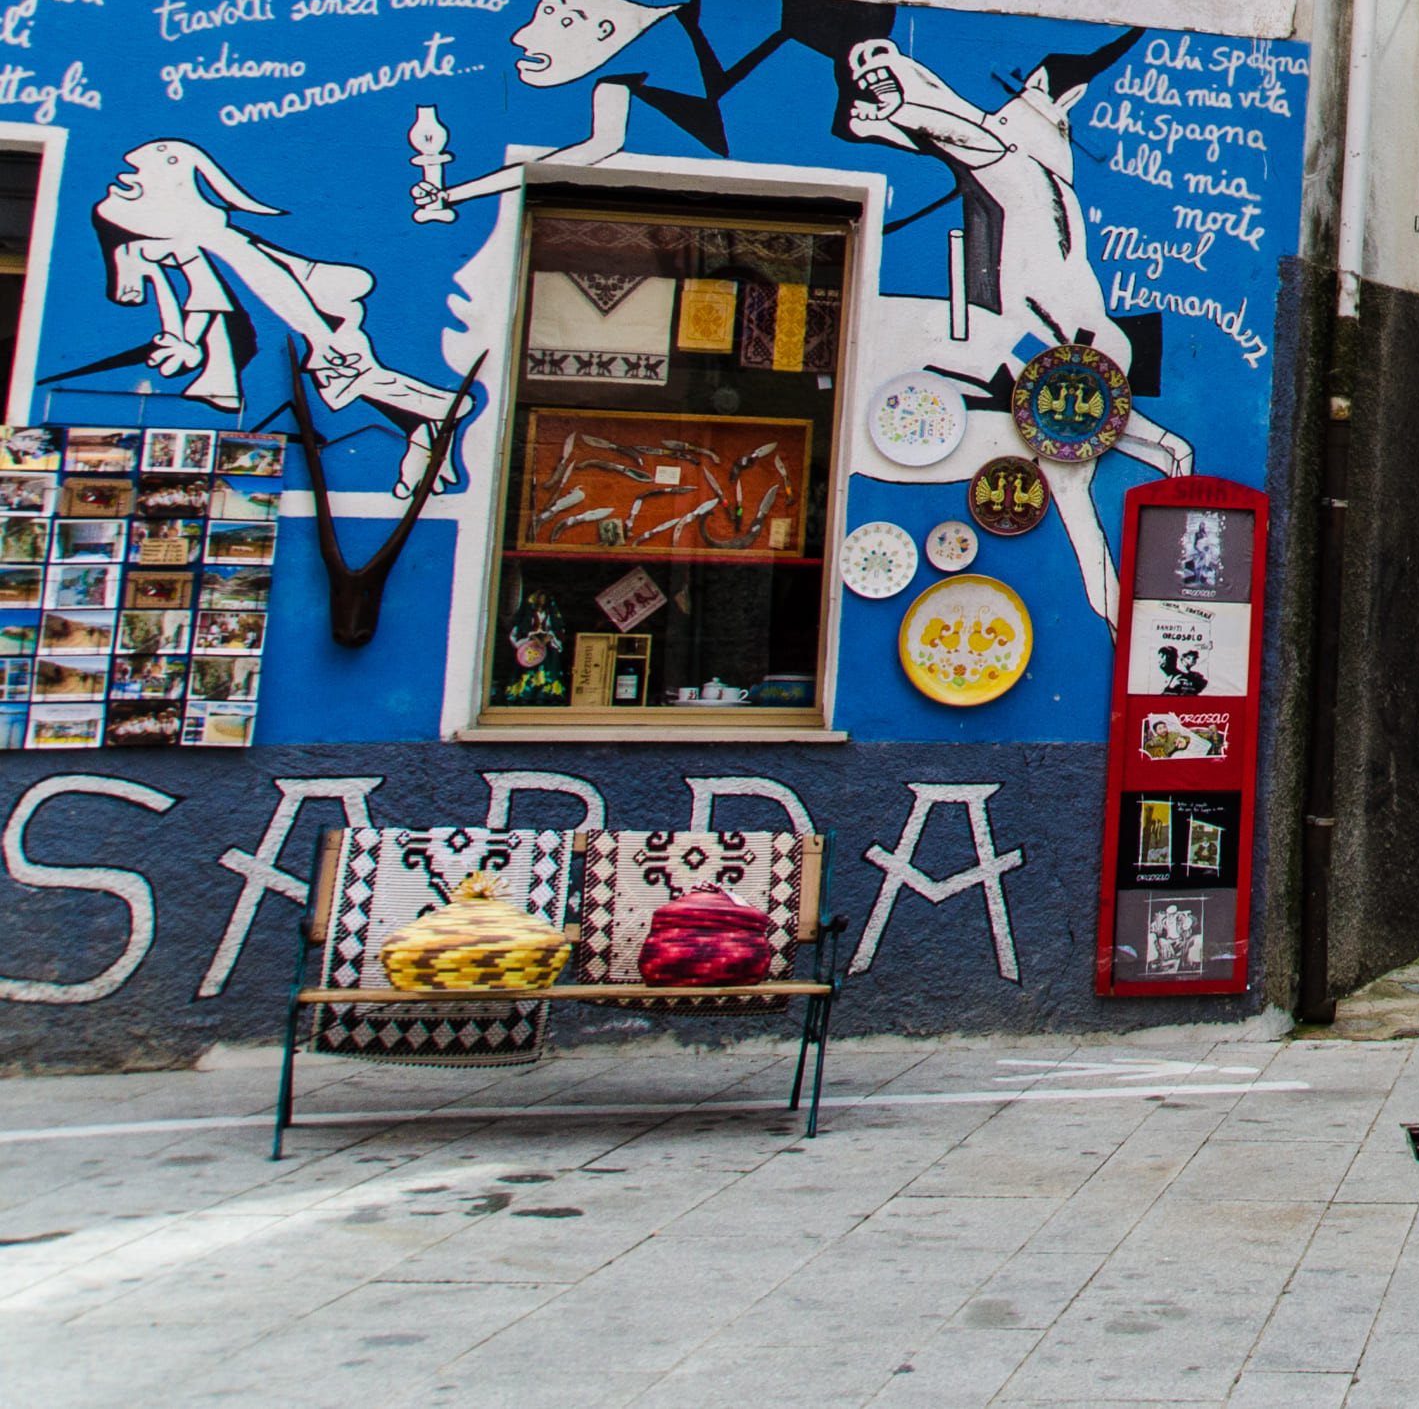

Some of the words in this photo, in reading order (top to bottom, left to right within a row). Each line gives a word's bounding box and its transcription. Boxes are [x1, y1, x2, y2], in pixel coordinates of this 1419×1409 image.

[160, 41, 307, 101] gridiamo
[1114, 65, 1182, 106] della
[1185, 87, 1233, 110] mia
[1238, 85, 1292, 118] vita
[1144, 35, 1204, 73] Ahi
[1209, 45, 1310, 90] Spagna
[1088, 101, 1146, 138] Ahi
[1147, 115, 1267, 163] Spagna
[1109, 141, 1173, 188] della
[1183, 169, 1261, 201] mia
[1173, 204, 1265, 252] morte
[1109, 271, 1269, 370] Hernandez
[1178, 712, 1230, 725] ORGOSOLO
[0, 770, 1026, 1004] SAA
